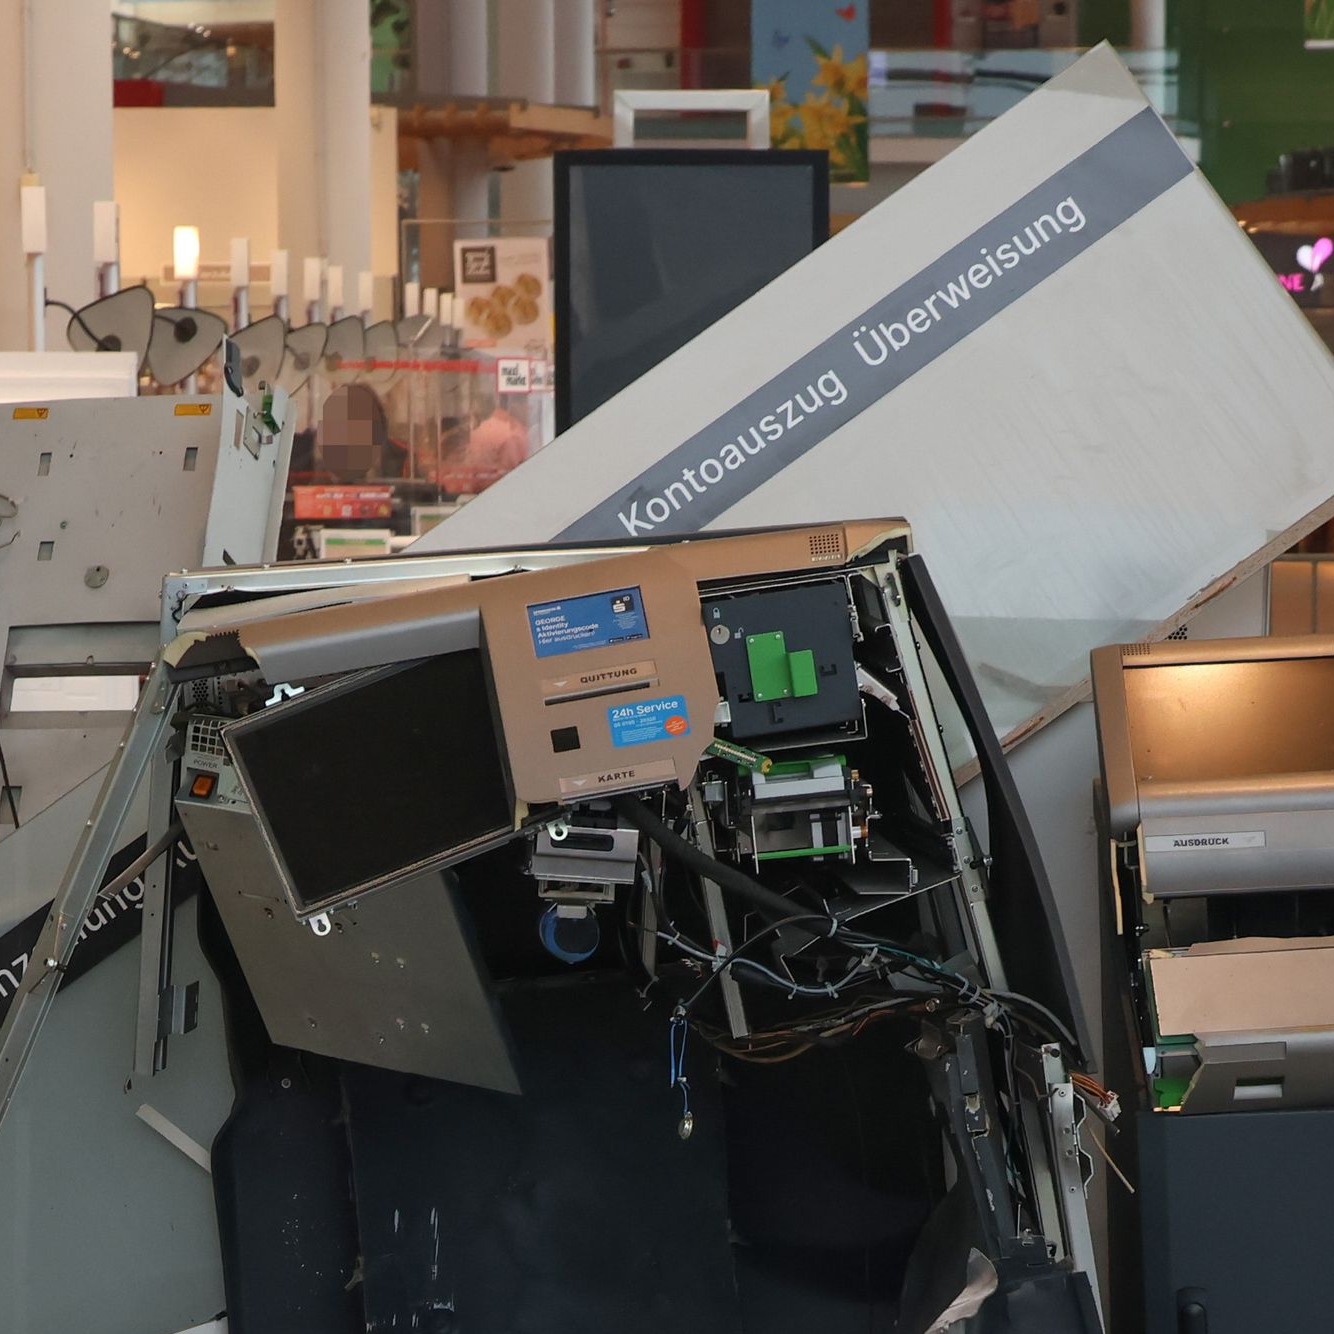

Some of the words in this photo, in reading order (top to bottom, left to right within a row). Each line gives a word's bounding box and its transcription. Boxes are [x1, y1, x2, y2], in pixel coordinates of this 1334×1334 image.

[617, 369, 849, 537] Kontoauszug
[853, 195, 1087, 366] Überweisung
[580, 667, 638, 684] QUITTUNG
[612, 707, 634, 719] 24h
[636, 700, 679, 715] Service
[193, 759, 219, 769] POWER
[597, 769, 636, 783] KARTE
[1173, 837, 1230, 848] AUSDRUCK
